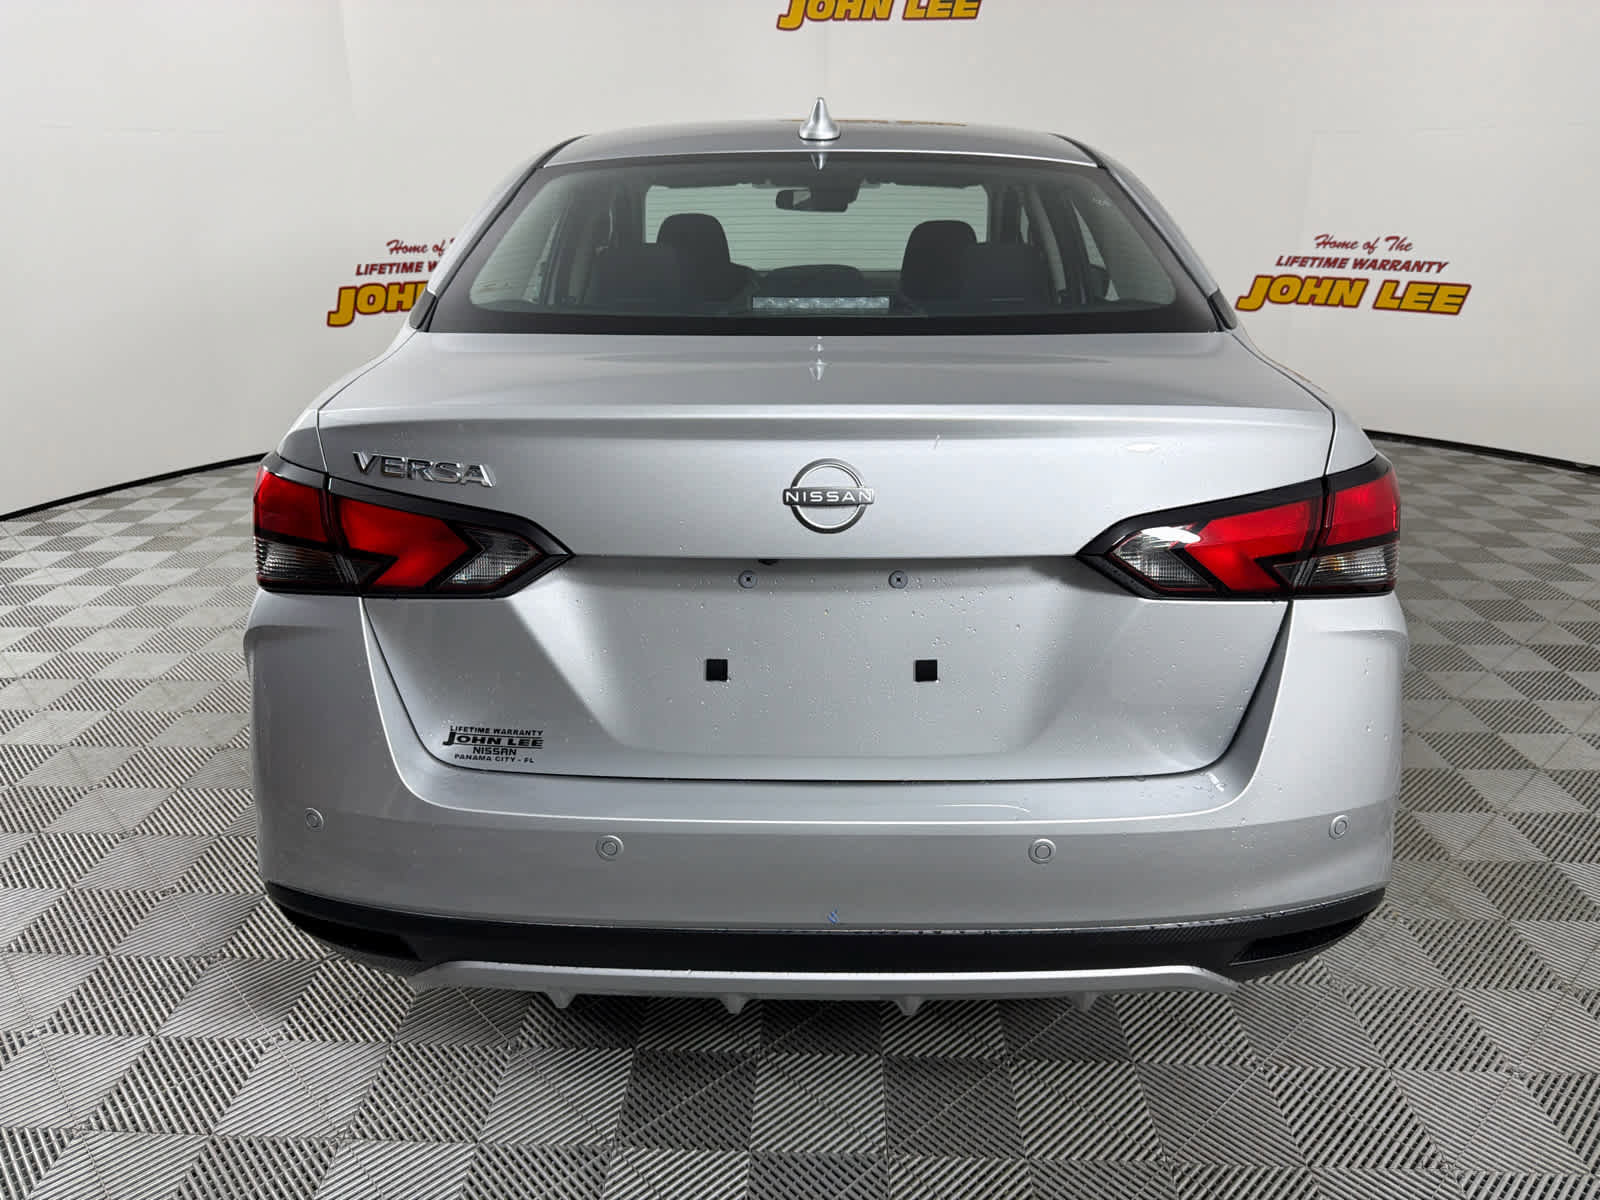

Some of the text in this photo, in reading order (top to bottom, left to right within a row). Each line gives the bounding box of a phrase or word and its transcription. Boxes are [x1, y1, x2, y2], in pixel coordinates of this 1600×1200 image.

[776, 0, 983, 30] JOHN LEE
[386, 239, 428, 255] Home
[1314, 233, 1414, 254] Home of The
[355, 261, 424, 276] LIFETIME
[1275, 255, 1449, 273] LIFETIME WARRANTY
[1235, 274, 1472, 315] JOHN LEE
[352, 450, 497, 488] VERSA
[785, 490, 873, 503] NISSAN
[450, 725, 544, 736] LIFETIME WARRANTY
[442, 732, 544, 747] JOHN LEE
[454, 754, 492, 762] PANAMA
[494, 755, 515, 763] CITY
[472, 746, 517, 756] NISSAN
